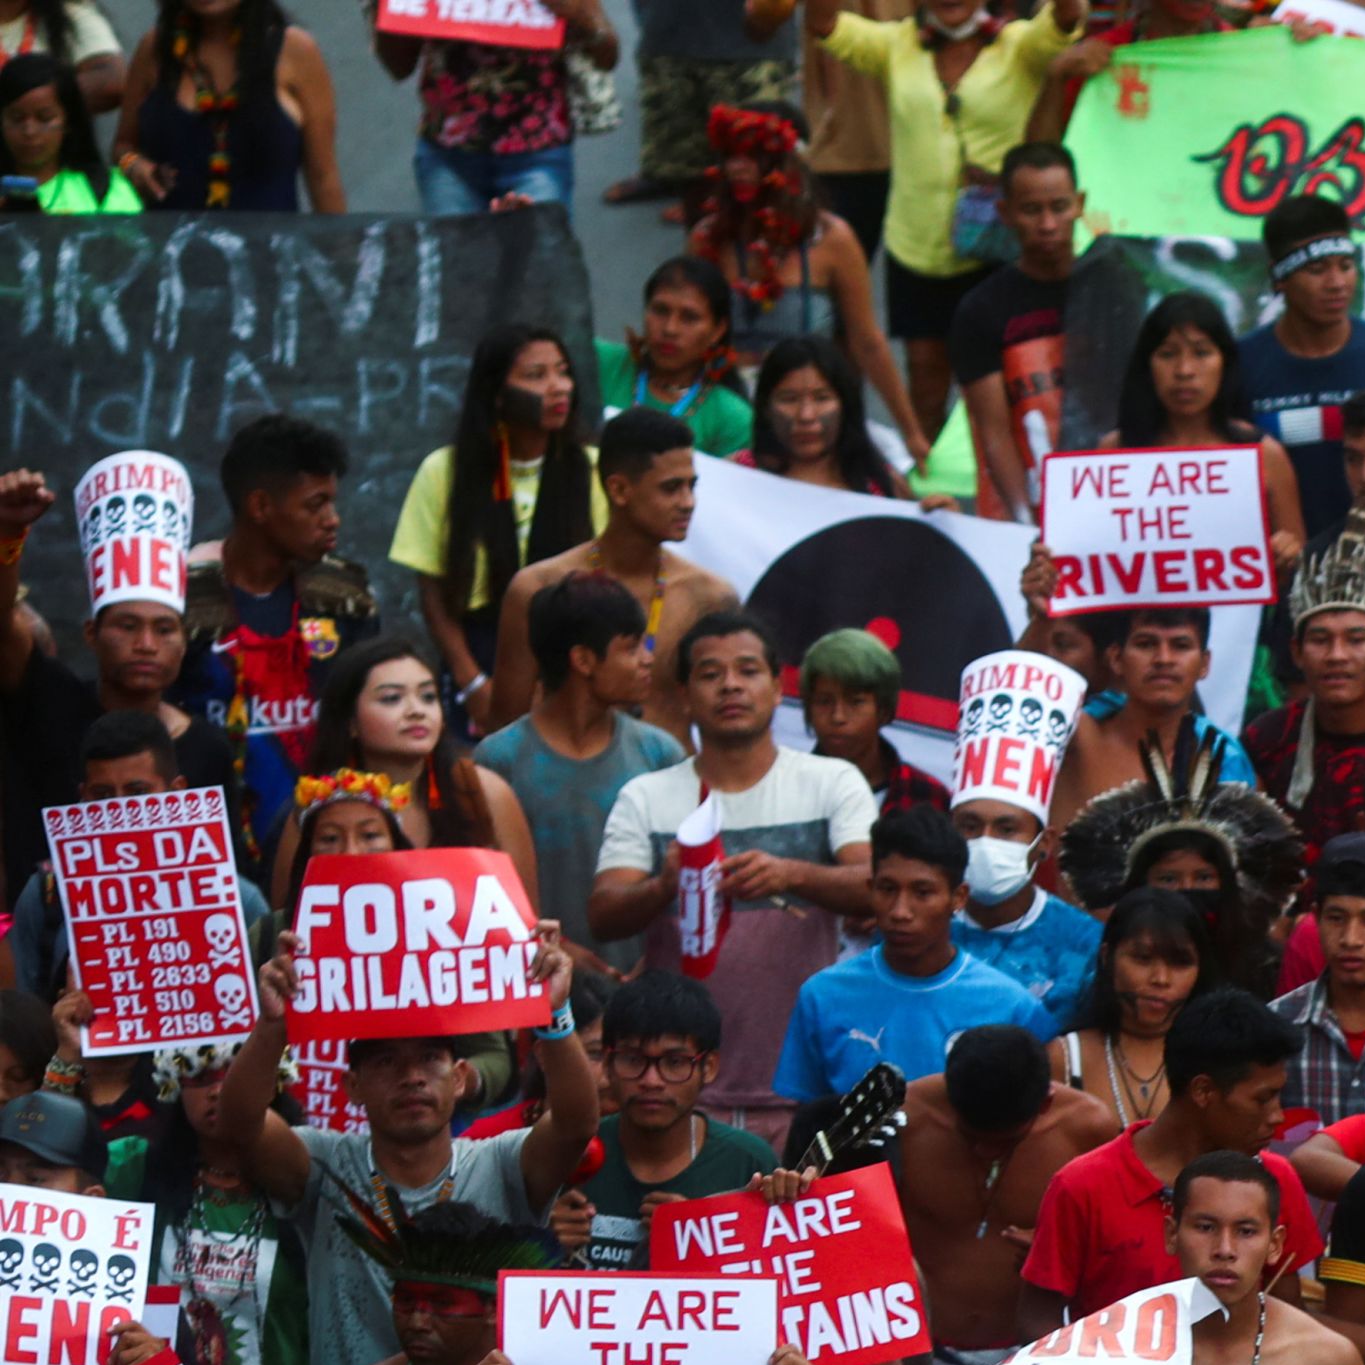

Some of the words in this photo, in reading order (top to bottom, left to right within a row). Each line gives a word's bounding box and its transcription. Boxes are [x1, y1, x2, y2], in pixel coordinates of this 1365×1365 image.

[1071, 465, 1131, 500] WE
[1147, 461, 1229, 497] ARE
[1110, 505, 1193, 542] THE
[1053, 546, 1264, 600] RIVERS
[156, 828, 223, 867] DA
[66, 861, 236, 919] MORTE:
[101, 921, 135, 944] PL
[144, 918, 180, 941] 191
[297, 874, 532, 955] FORA
[104, 946, 138, 969] PL
[148, 941, 191, 964] 490
[109, 970, 144, 993] PL
[151, 965, 211, 988] 2633
[293, 941, 542, 1013] GRILAGEM!
[113, 995, 149, 1017] PL
[155, 989, 196, 1012] 510
[117, 1020, 152, 1042] PL
[158, 1013, 215, 1037] 2156
[113, 1208, 142, 1252] É
[672, 1212, 745, 1261] WE
[761, 1189, 863, 1250] ARE
[539, 1288, 617, 1331] WE
[636, 1288, 741, 1331] ARE
[781, 1281, 921, 1360] TAINS
